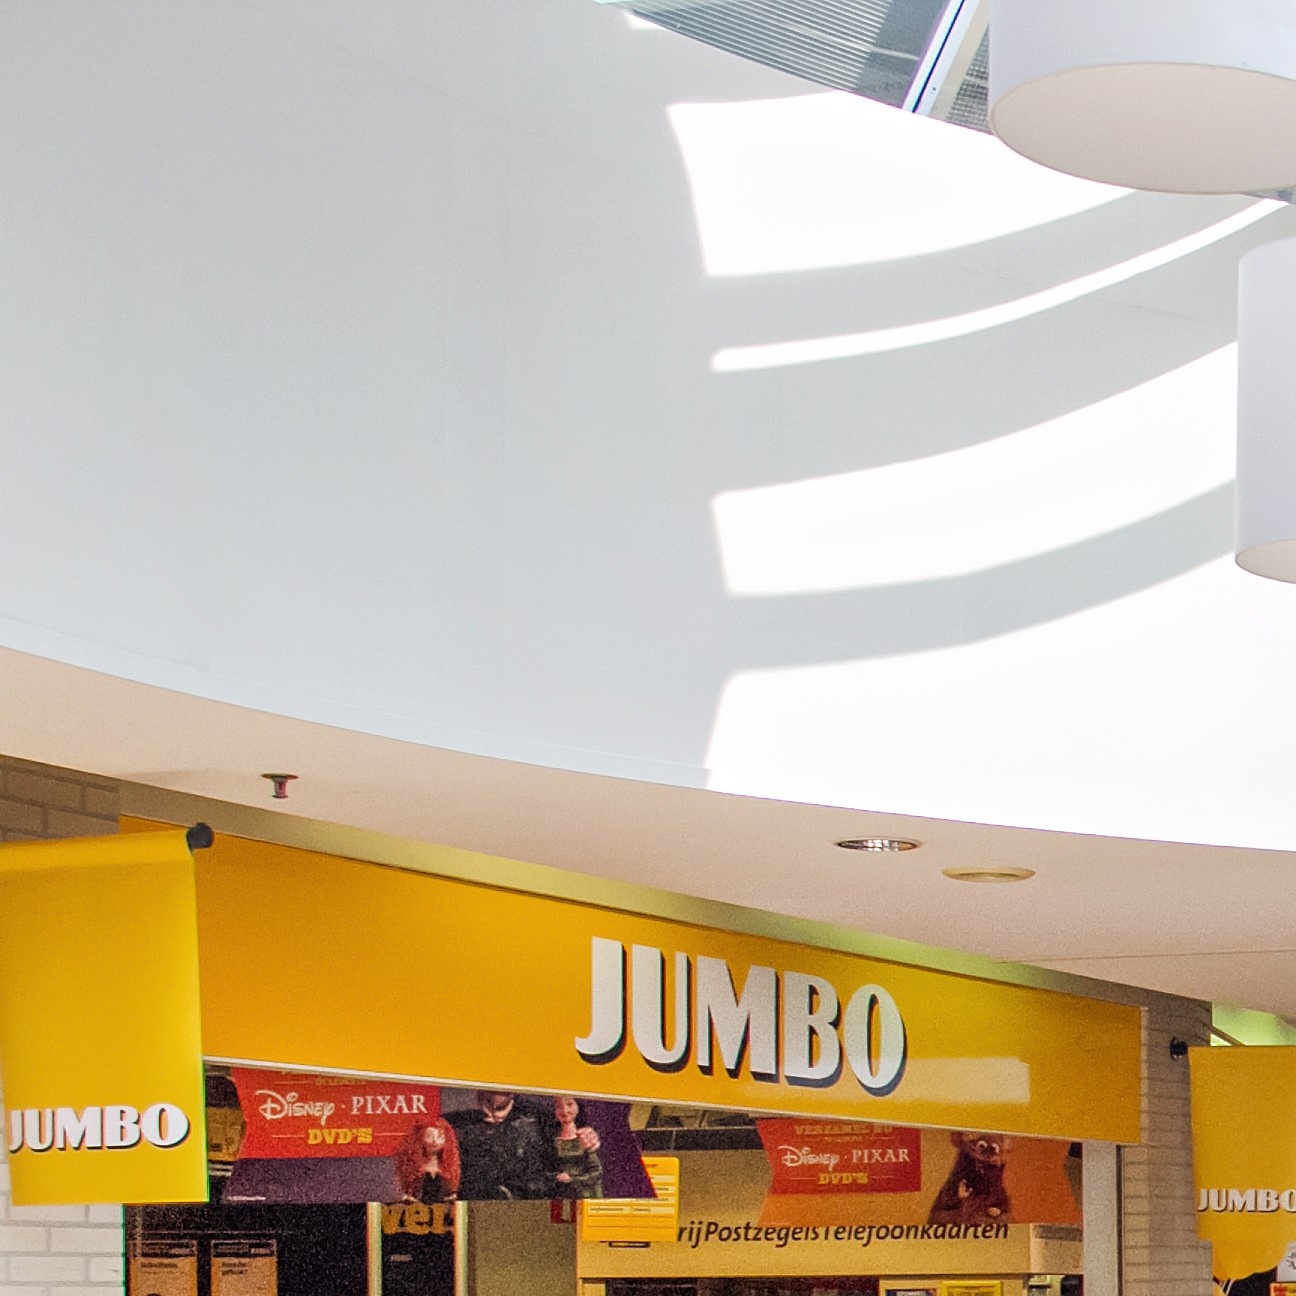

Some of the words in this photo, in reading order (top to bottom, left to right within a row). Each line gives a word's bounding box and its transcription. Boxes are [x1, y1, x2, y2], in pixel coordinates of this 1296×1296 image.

[575, 936, 907, 1097] JUMBO
[351, 1094, 428, 1114] PIXAR
[9, 1103, 190, 1154] JUMBO
[307, 1127, 373, 1145] DVD'S
[852, 1149, 911, 1164] PIXAR
